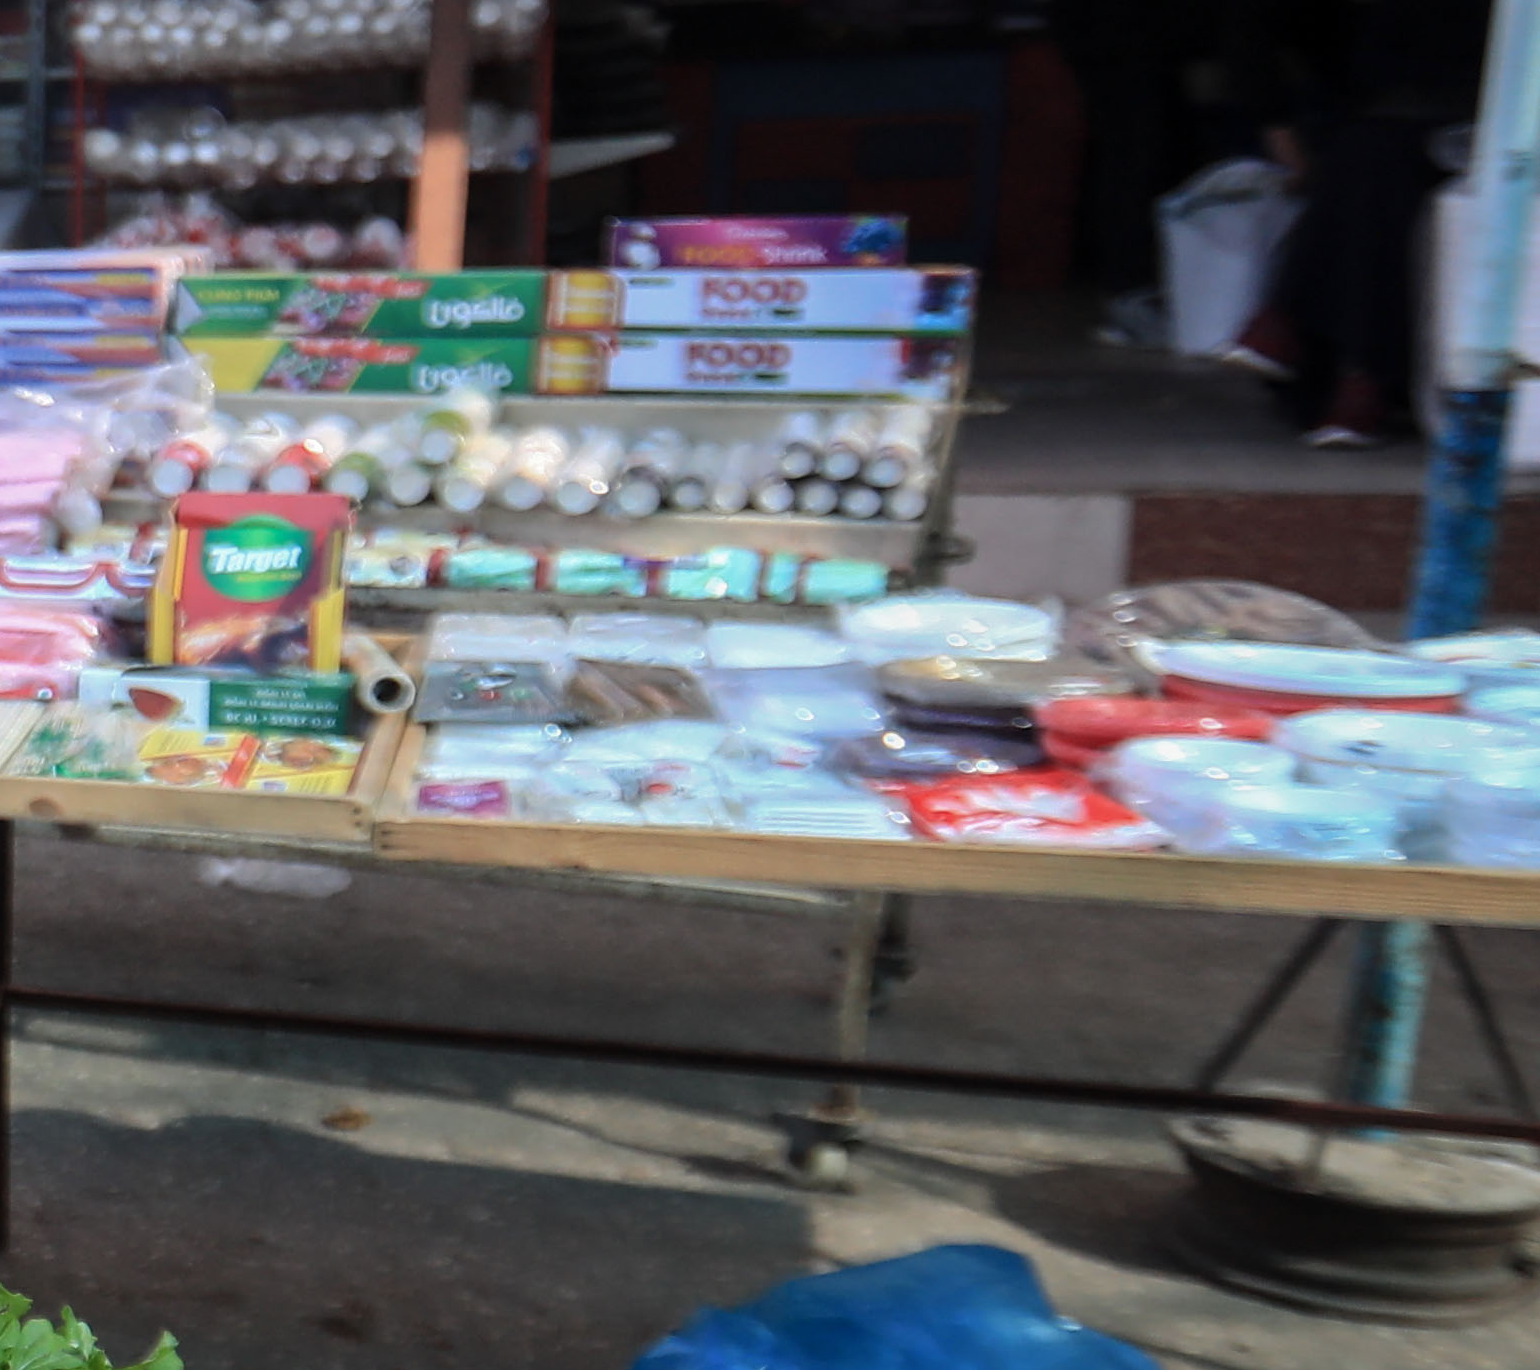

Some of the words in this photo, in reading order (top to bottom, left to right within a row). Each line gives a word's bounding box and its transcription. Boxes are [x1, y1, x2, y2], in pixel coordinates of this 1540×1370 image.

[702, 277, 808, 304] FOOD
[686, 342, 792, 369] FOOD
[210, 542, 302, 574] Target
